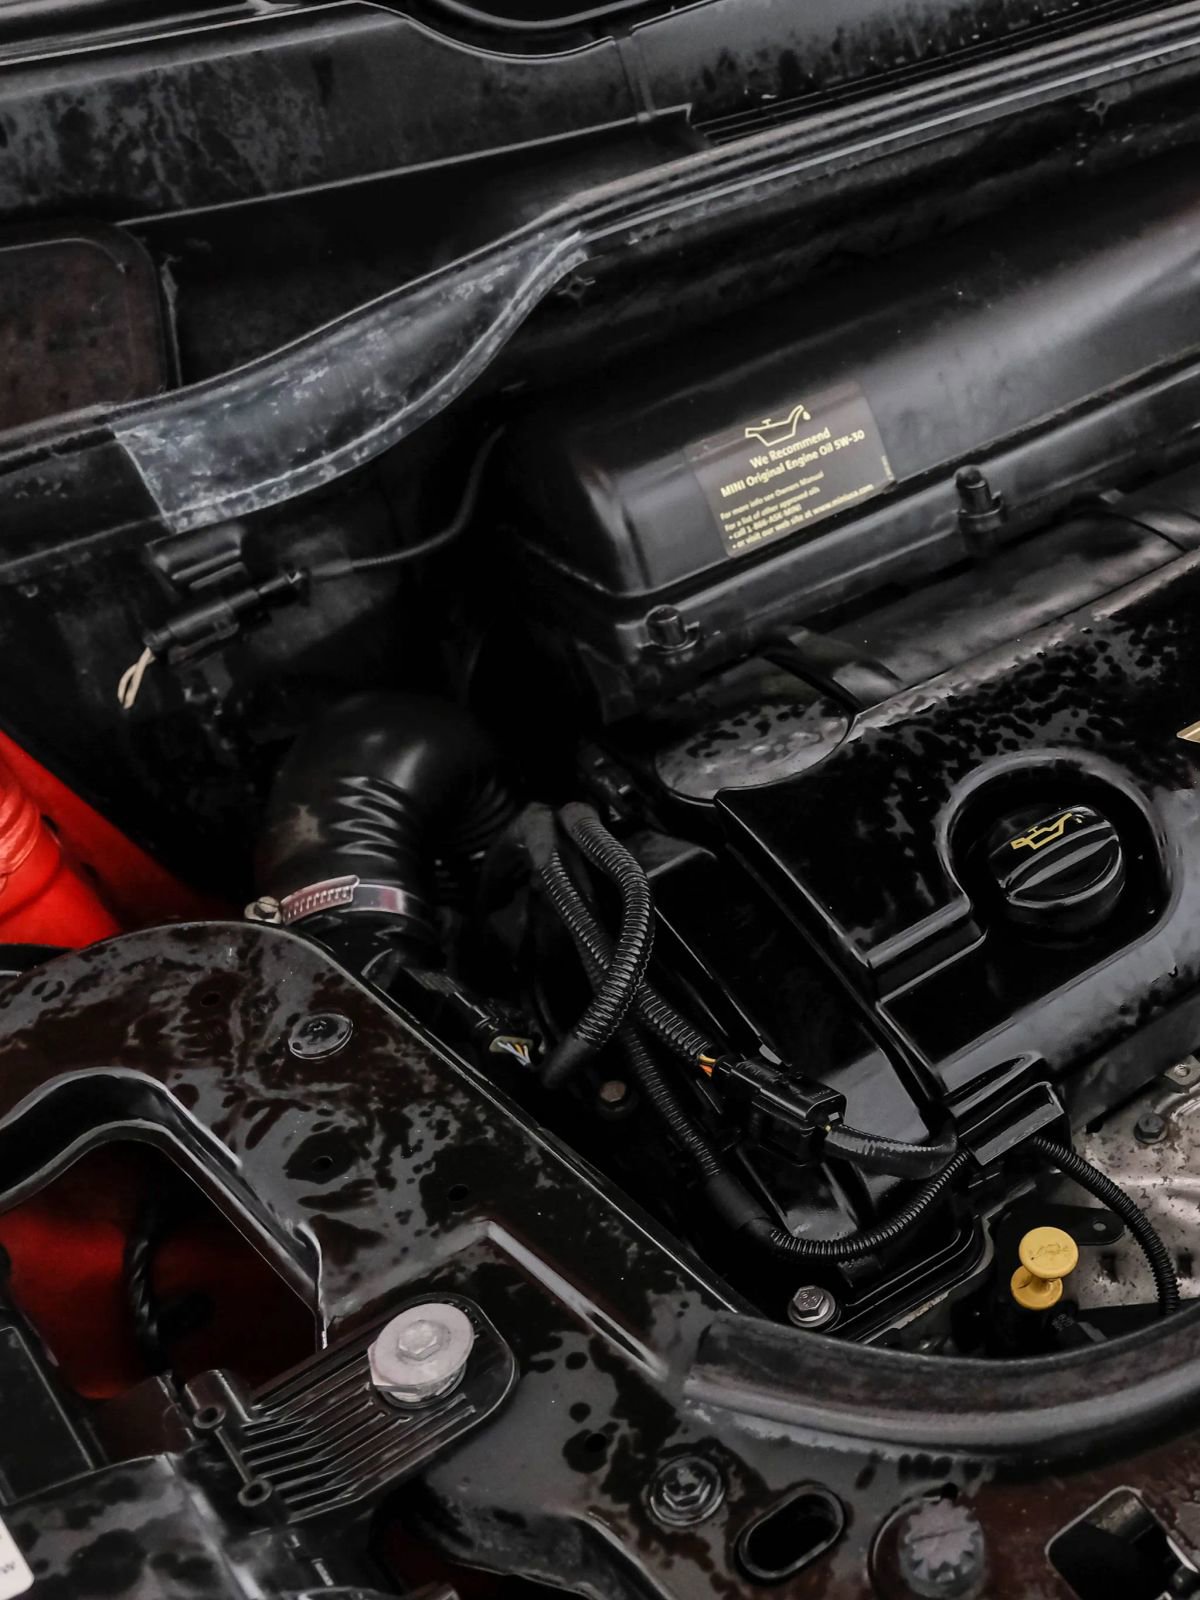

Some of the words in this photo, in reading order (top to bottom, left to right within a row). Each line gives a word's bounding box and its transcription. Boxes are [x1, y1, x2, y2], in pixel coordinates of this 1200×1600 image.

[720, 479, 746, 498] MINI
[746, 462, 785, 486] Original
[785, 451, 819, 471] Engine
[819, 442, 834, 456] Oil
[833, 429, 865, 451] 5W-30
[749, 455, 769, 469] We
[769, 427, 831, 462] Recommend
